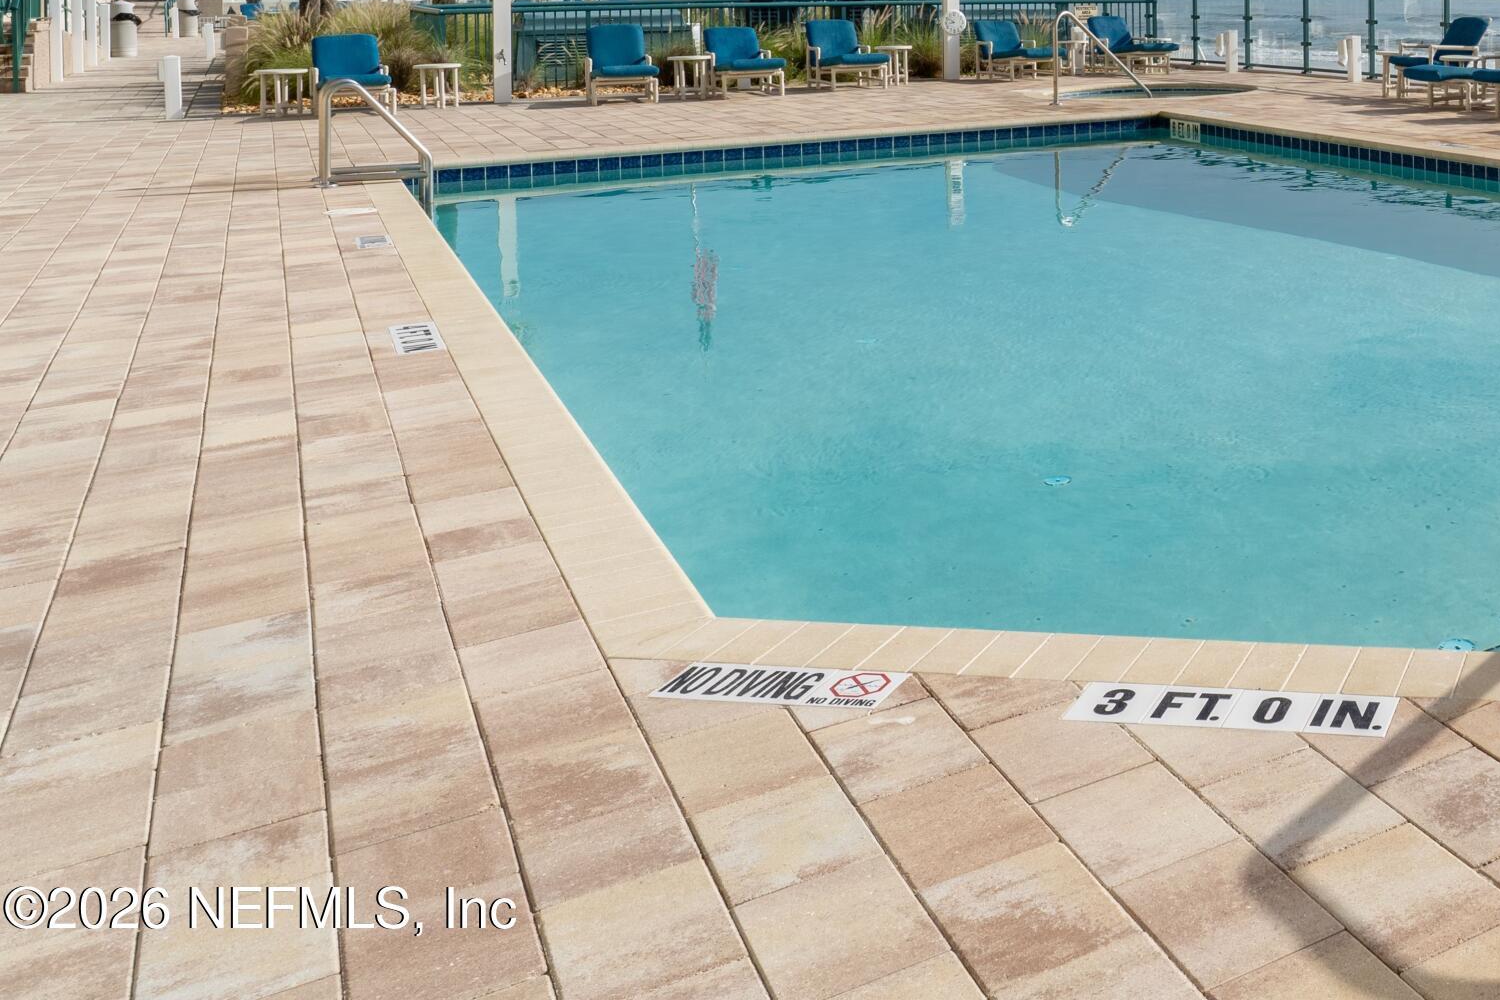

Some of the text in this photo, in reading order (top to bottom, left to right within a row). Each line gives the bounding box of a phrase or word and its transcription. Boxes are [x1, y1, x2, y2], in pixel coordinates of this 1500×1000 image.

[659, 666, 825, 700] NO DIVING
[806, 696, 877, 707] NO DIVING
[1093, 688, 1383, 731] 3 FT. 0 IN.
